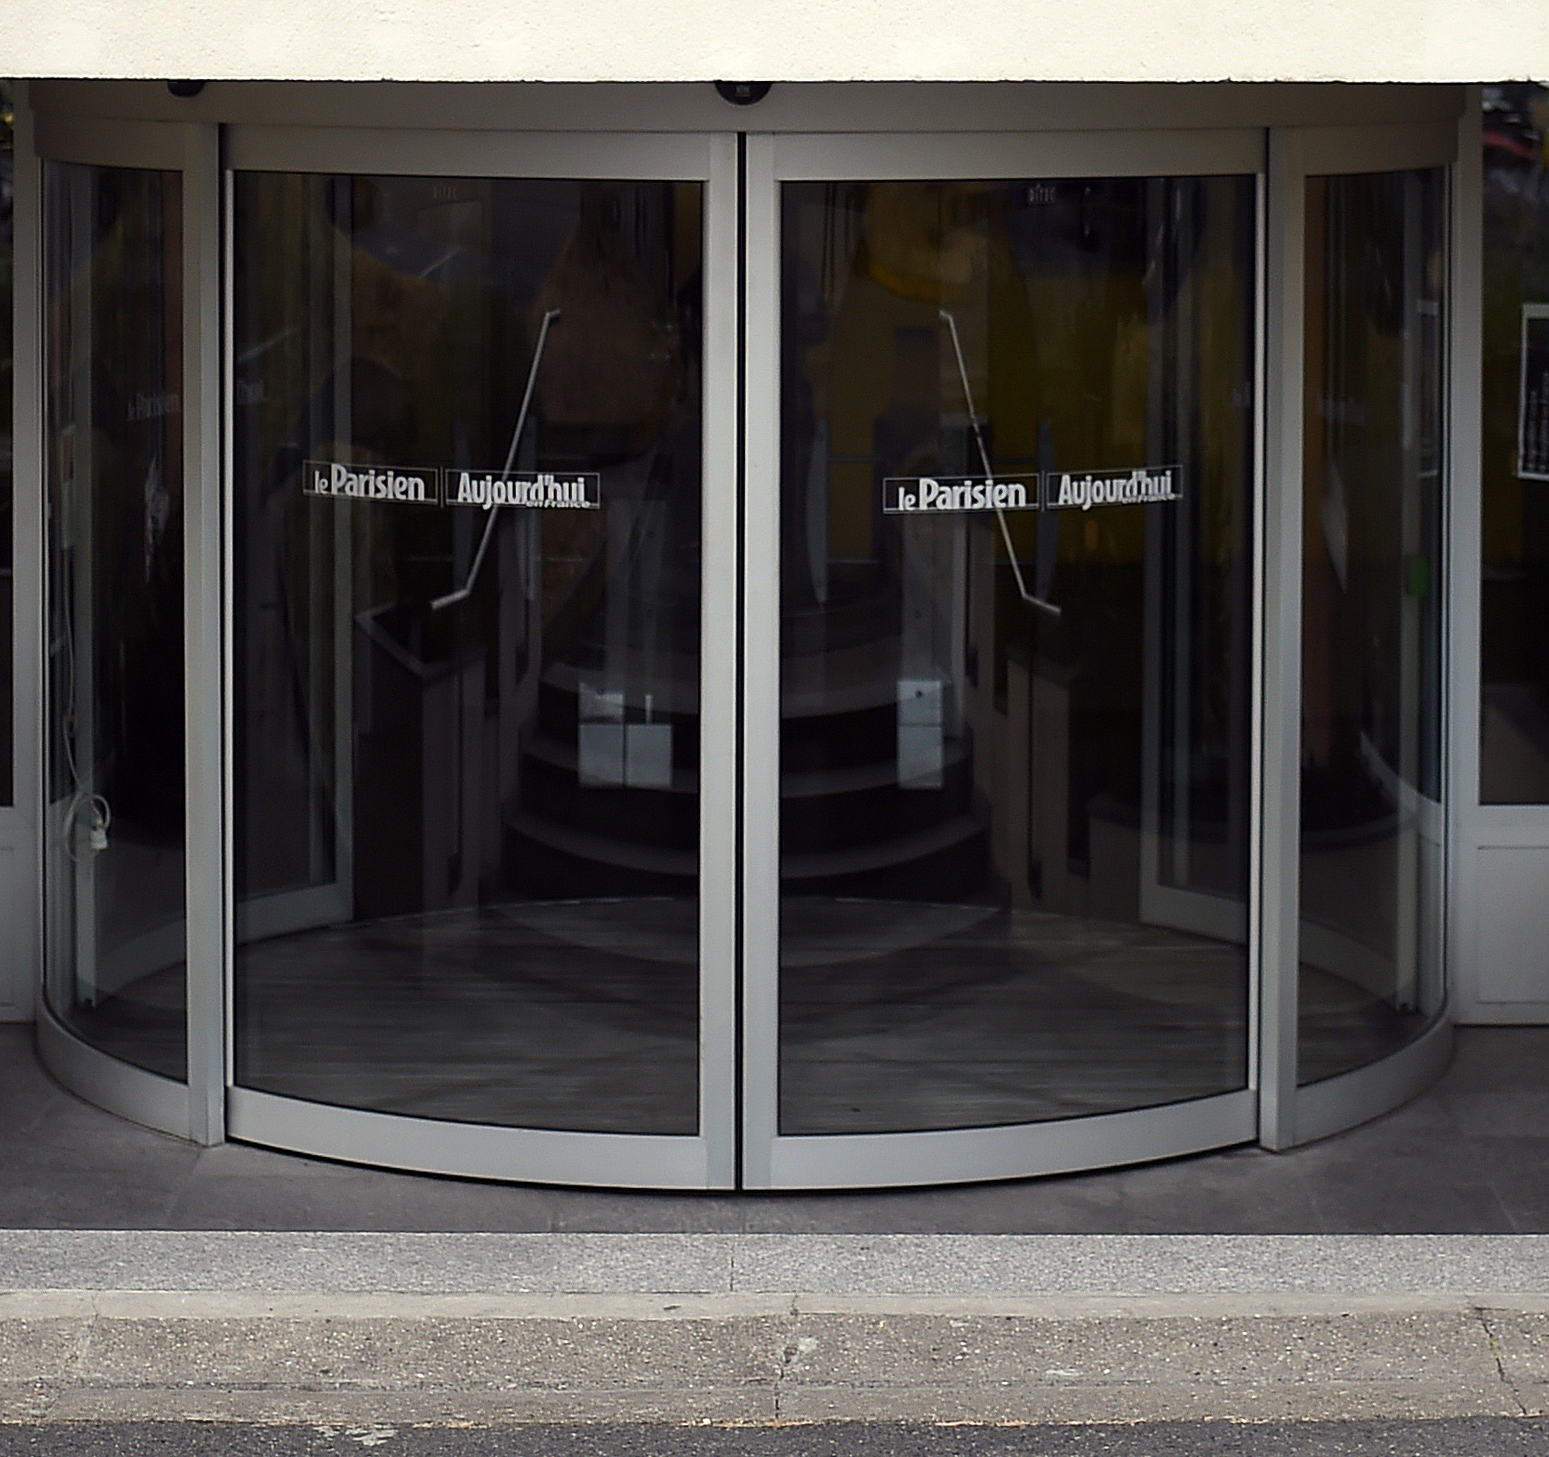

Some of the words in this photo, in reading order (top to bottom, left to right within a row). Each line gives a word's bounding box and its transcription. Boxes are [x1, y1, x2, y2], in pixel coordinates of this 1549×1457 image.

[314, 470, 329, 495] le
[331, 462, 426, 501] Parisien
[458, 472, 586, 511] Aujourd'hui
[898, 486, 916, 512] le
[919, 477, 1027, 510] Parisien
[1058, 470, 1172, 512] Aujourd'hui
